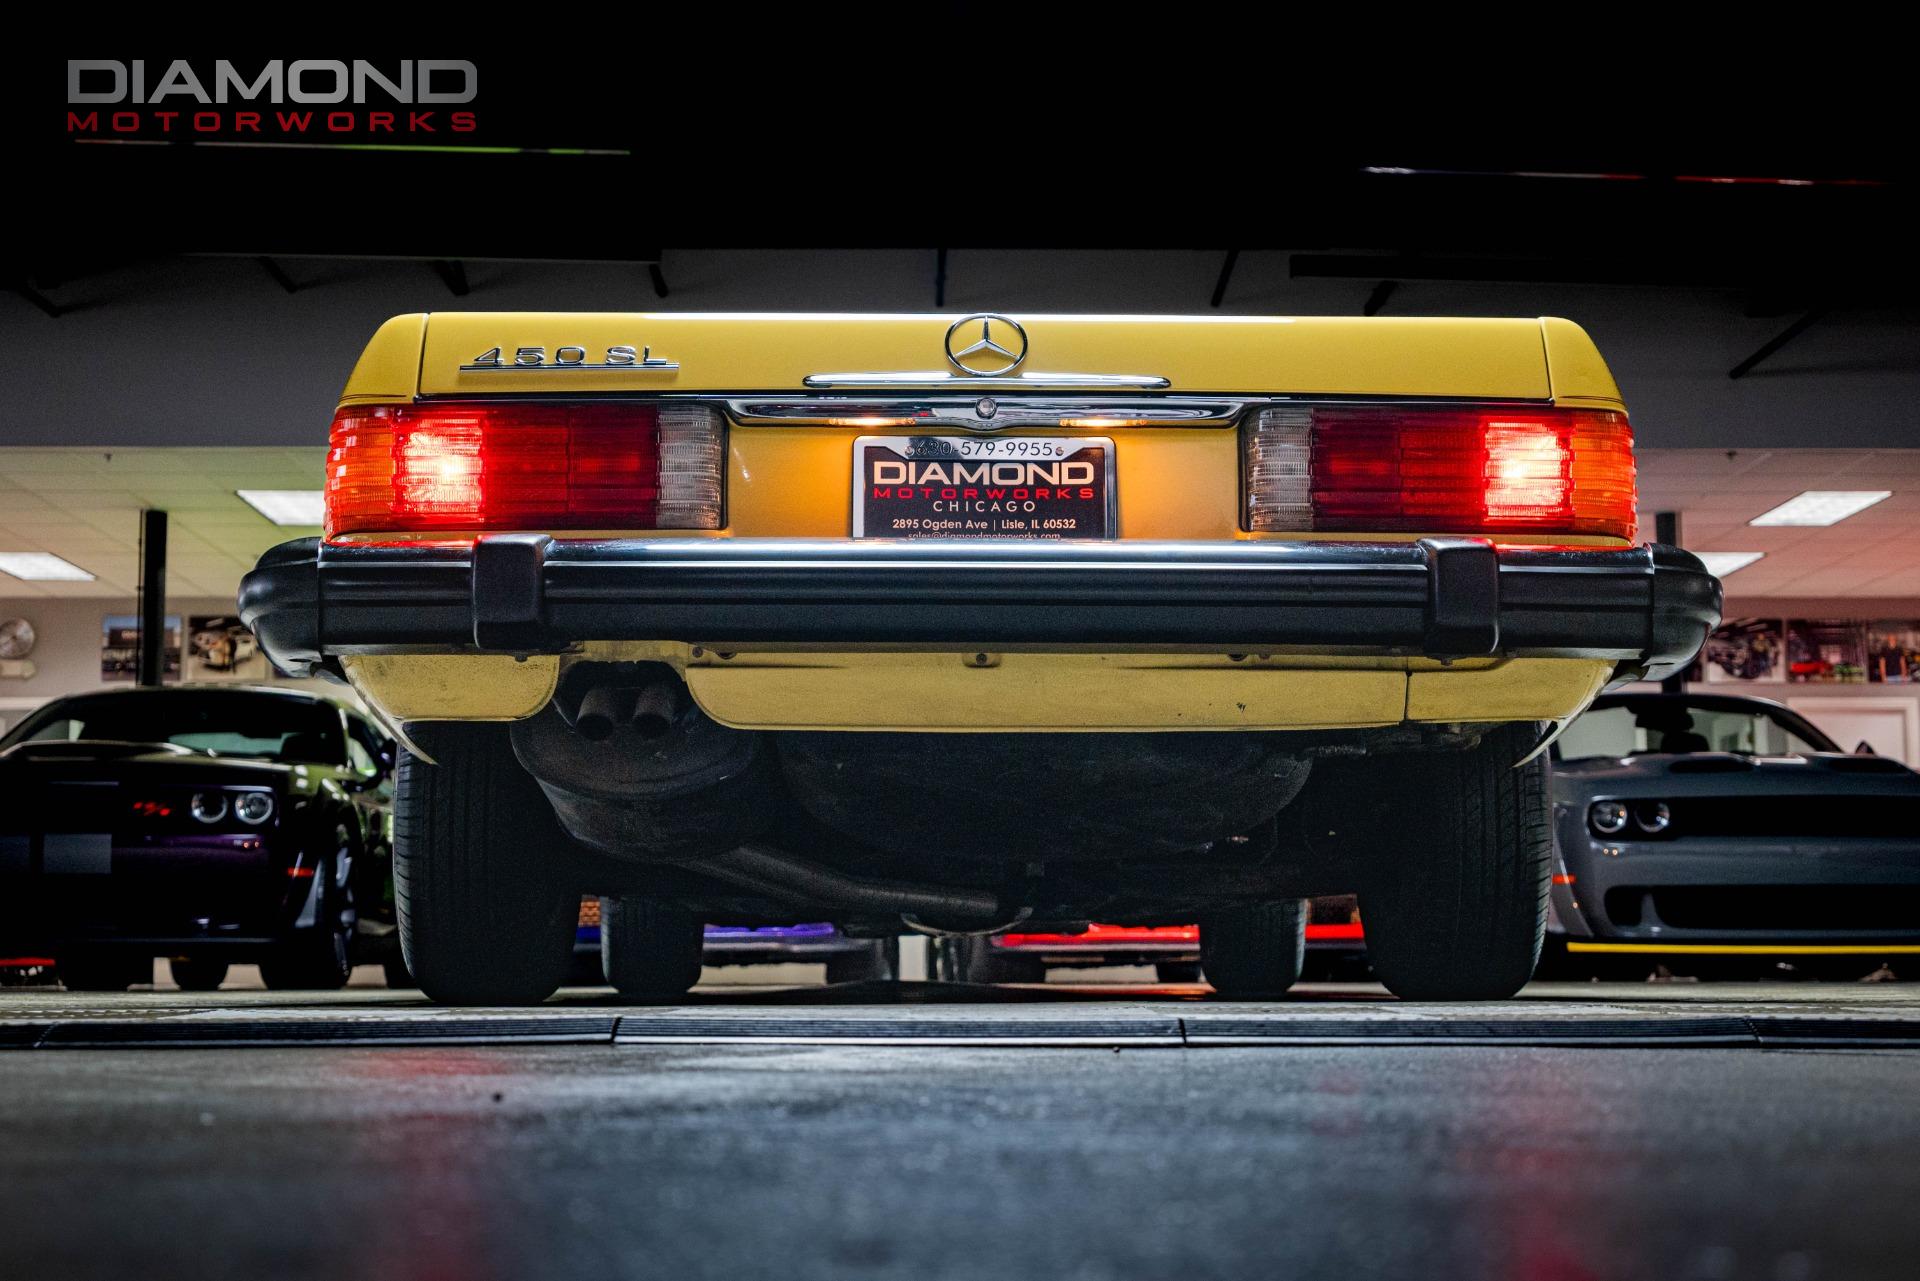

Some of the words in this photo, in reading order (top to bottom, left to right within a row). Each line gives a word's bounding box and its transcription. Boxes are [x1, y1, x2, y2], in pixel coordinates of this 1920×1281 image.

[474, 346, 585, 366] 450
[606, 345, 667, 366] SL
[917, 441, 1053, 457] 630-579-9955
[873, 461, 1094, 485] DIAMOND
[873, 487, 1094, 500] MOTORWORKS
[933, 501, 1036, 513] CHICAGO
[892, 519, 919, 529] 2895
[922, 519, 962, 531] Ogden
[965, 519, 988, 529] Ave
[1001, 519, 1028, 530] Lisle,
[1031, 519, 1041, 529] IL
[1043, 519, 1076, 529] 60532
